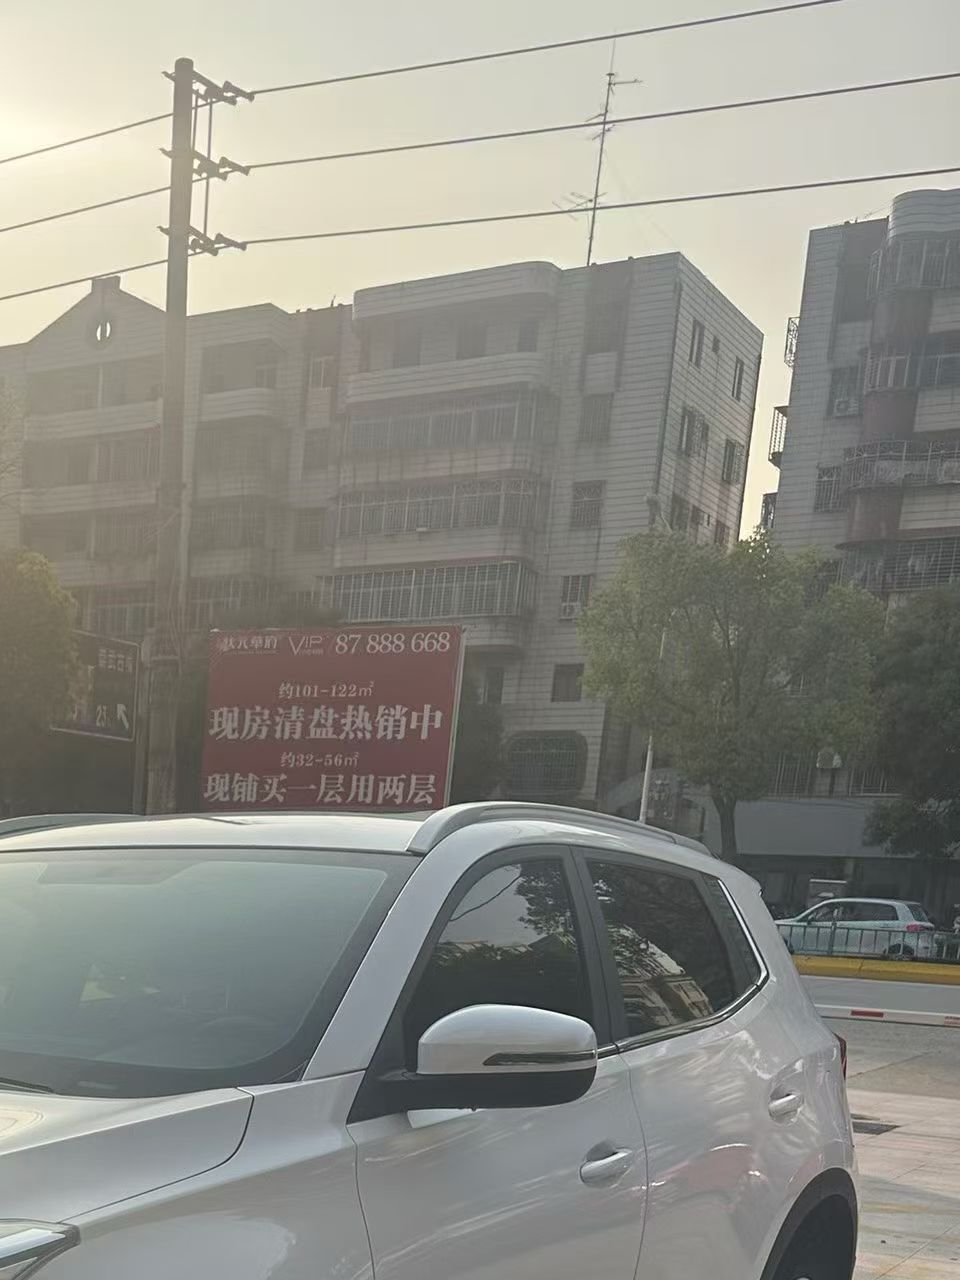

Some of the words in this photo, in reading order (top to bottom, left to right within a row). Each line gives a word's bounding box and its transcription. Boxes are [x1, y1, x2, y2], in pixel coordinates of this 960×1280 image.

[289, 635, 323, 656] VIP
[335, 633, 361, 654] 87
[366, 632, 405, 654] 888
[411, 631, 450, 653] 668
[208, 704, 443, 741] 现房清盘热销中
[203, 772, 436, 804] 现铺买一层用两层
